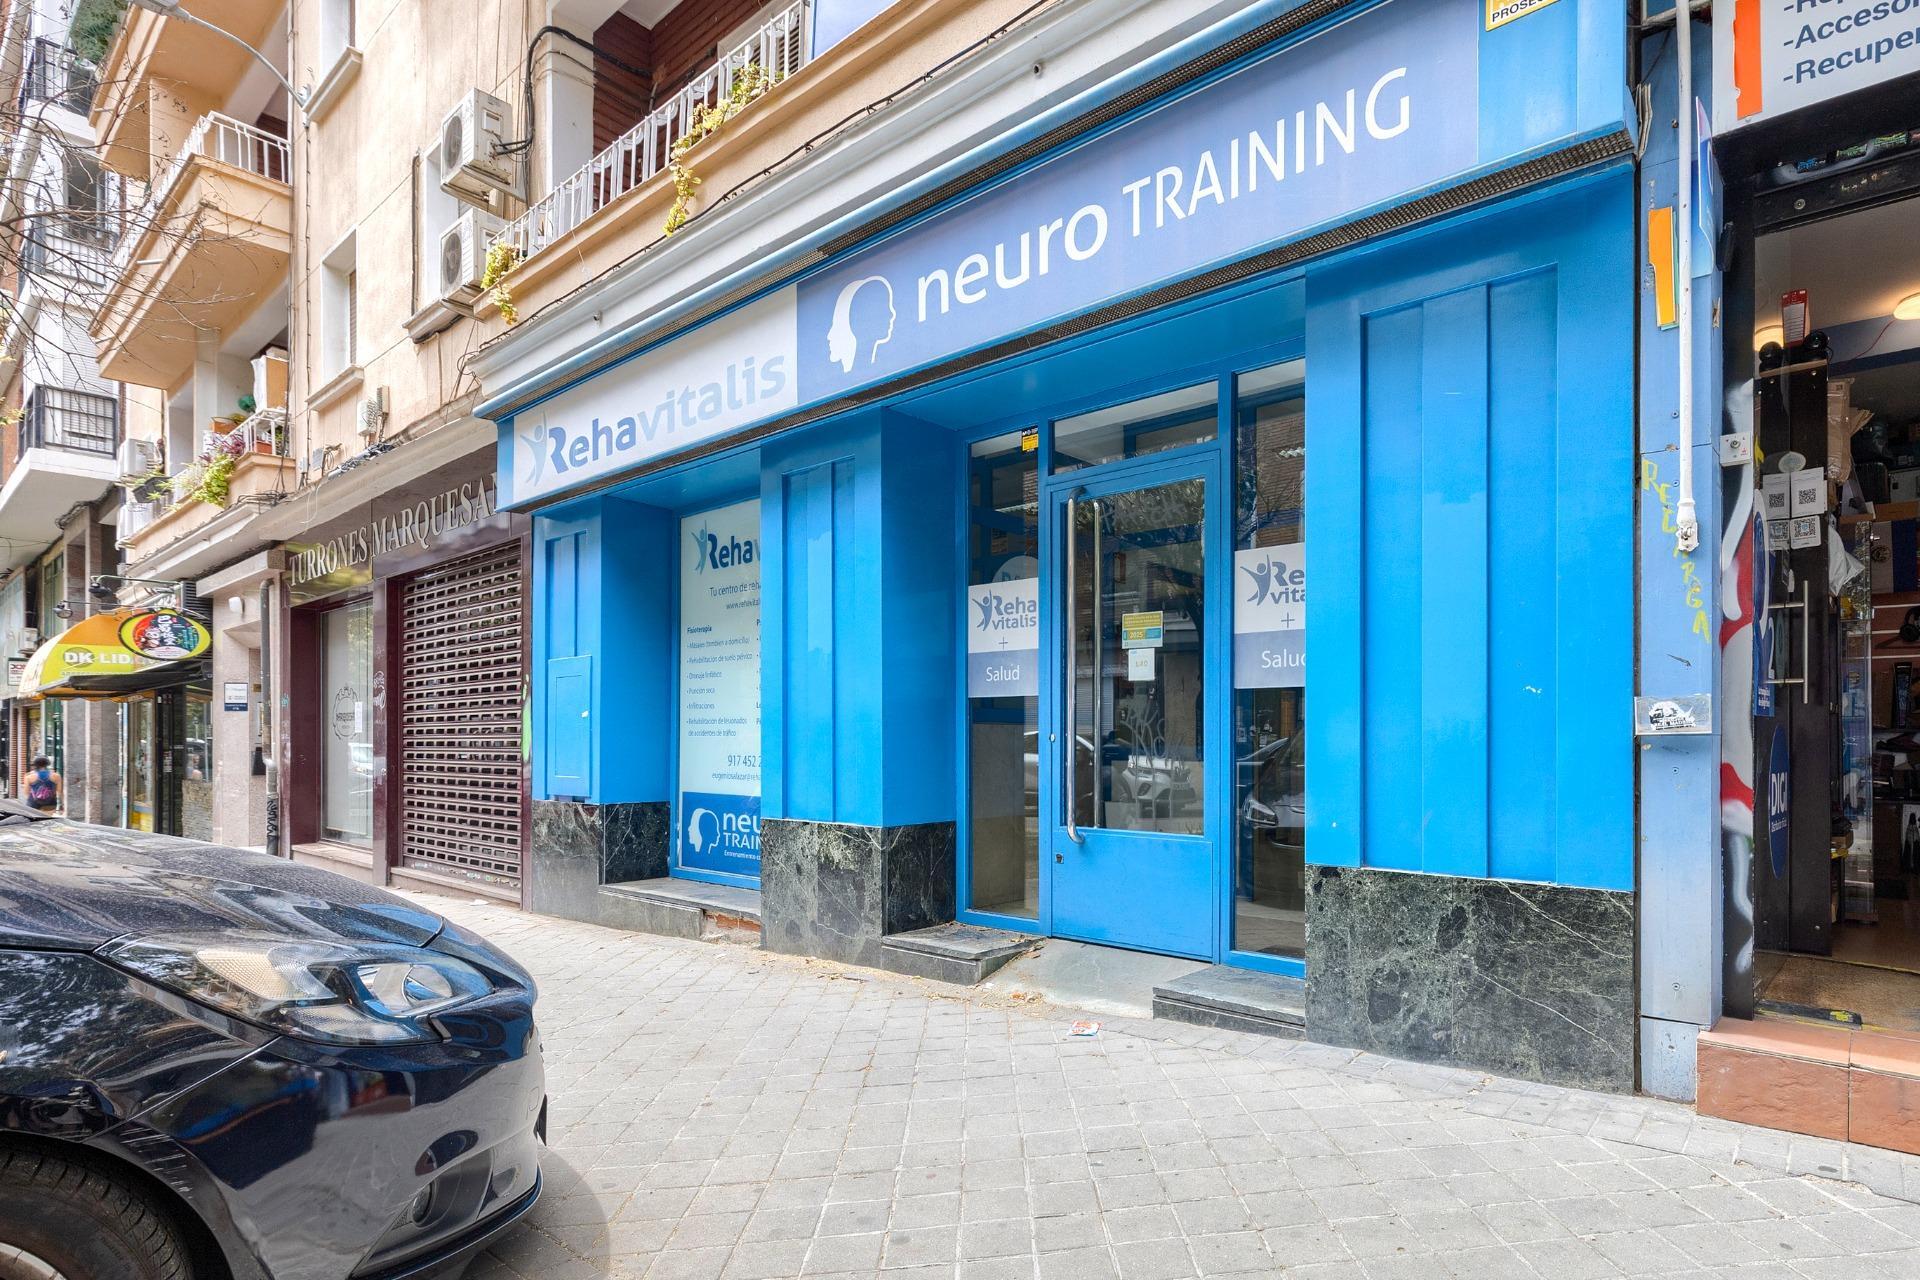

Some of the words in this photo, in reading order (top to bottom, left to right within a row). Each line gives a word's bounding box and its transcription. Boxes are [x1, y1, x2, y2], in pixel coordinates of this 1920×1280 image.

[1492, 0, 1544, 22] PROSE
[917, 204, 1108, 323] neuro
[1122, 66, 1411, 238] TRAINING
[548, 354, 786, 475] Rehavitalis
[289, 526, 368, 588] TURRONES
[709, 587, 718, 597] Tu
[718, 585, 739, 596] centro
[739, 583, 748, 593] de
[748, 580, 761, 590] reh
[992, 594, 1038, 617] Reha
[992, 607, 1038, 631] vitalis
[64, 651, 95, 664] DK
[986, 667, 1020, 682] Salud
[728, 755, 741, 767] 917
[743, 755, 756, 767] 452
[1771, 772, 1788, 816] DIGI
